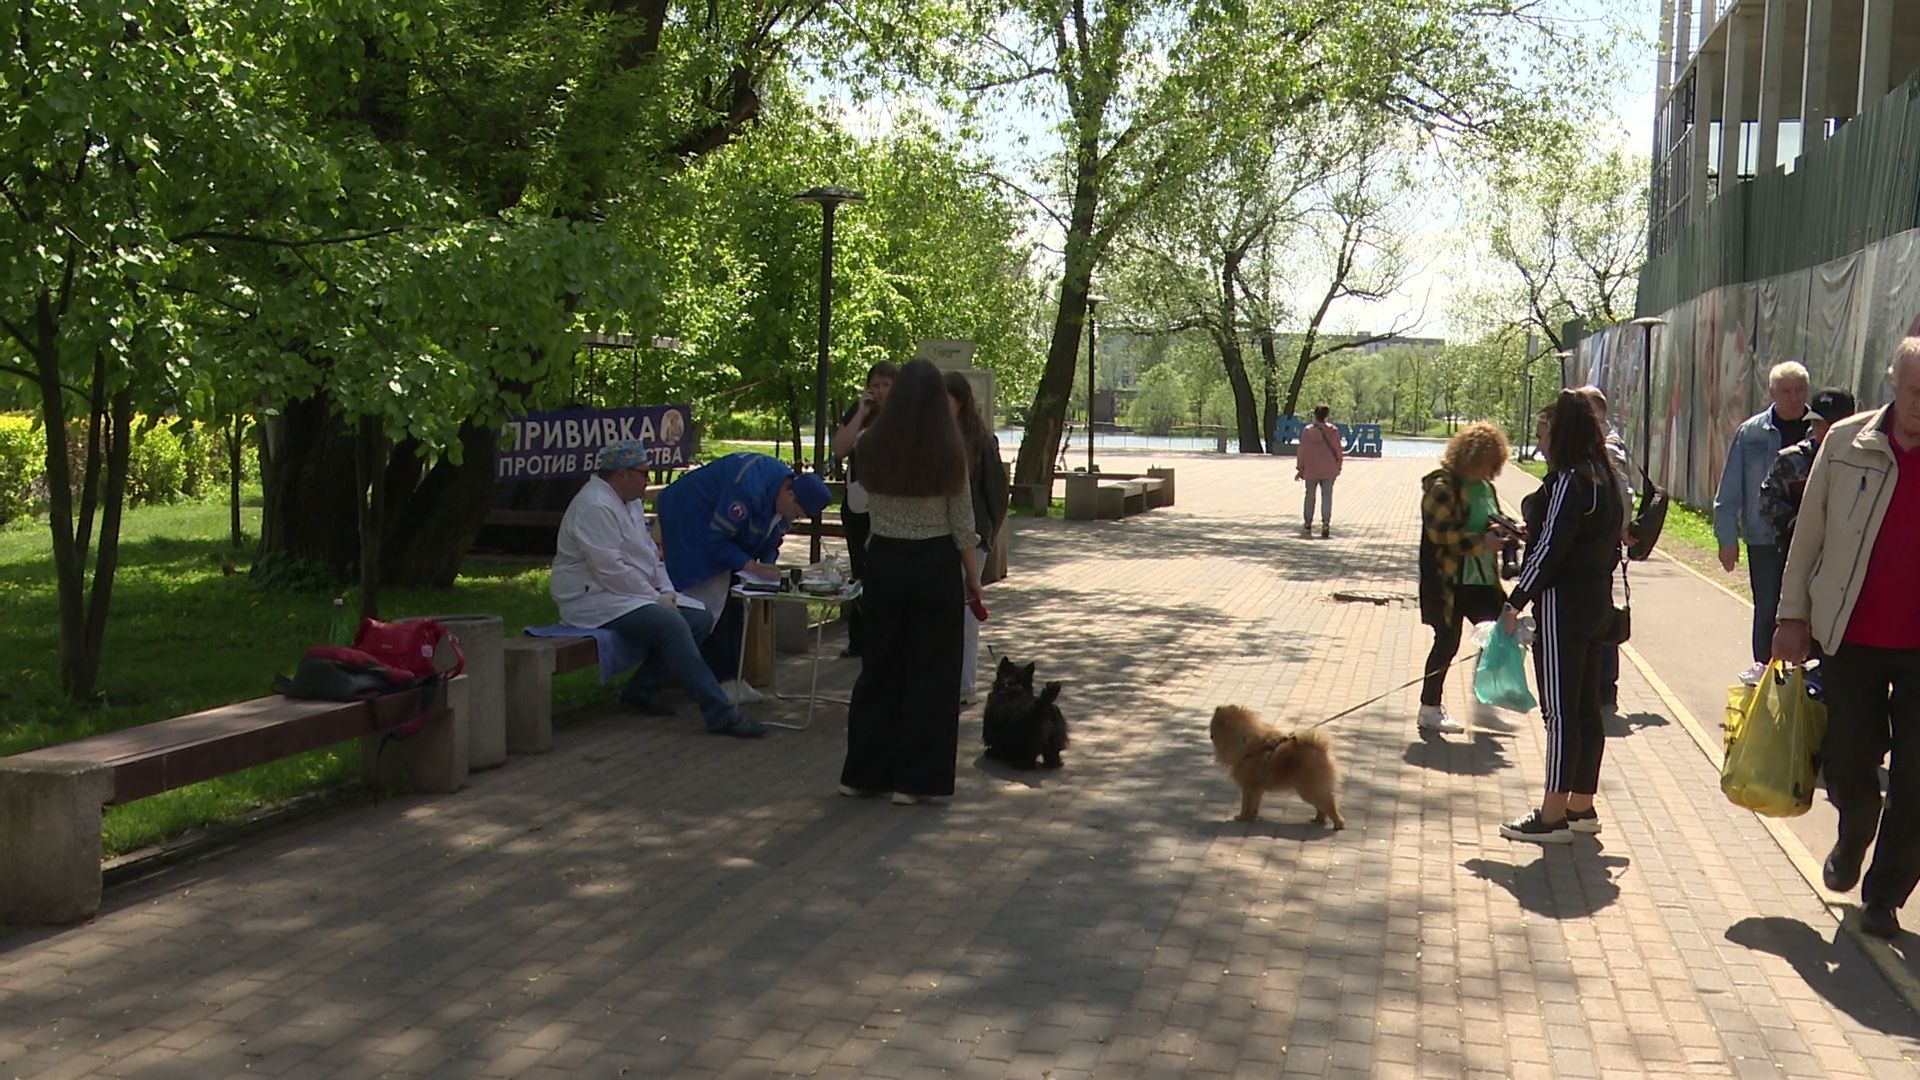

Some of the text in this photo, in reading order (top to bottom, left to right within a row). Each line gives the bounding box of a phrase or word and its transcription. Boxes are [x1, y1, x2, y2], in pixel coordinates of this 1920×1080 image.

[501, 415, 656, 451] ПРИВИВКА
[499, 446, 683, 477] ПРОТИВ БЕСТВА
